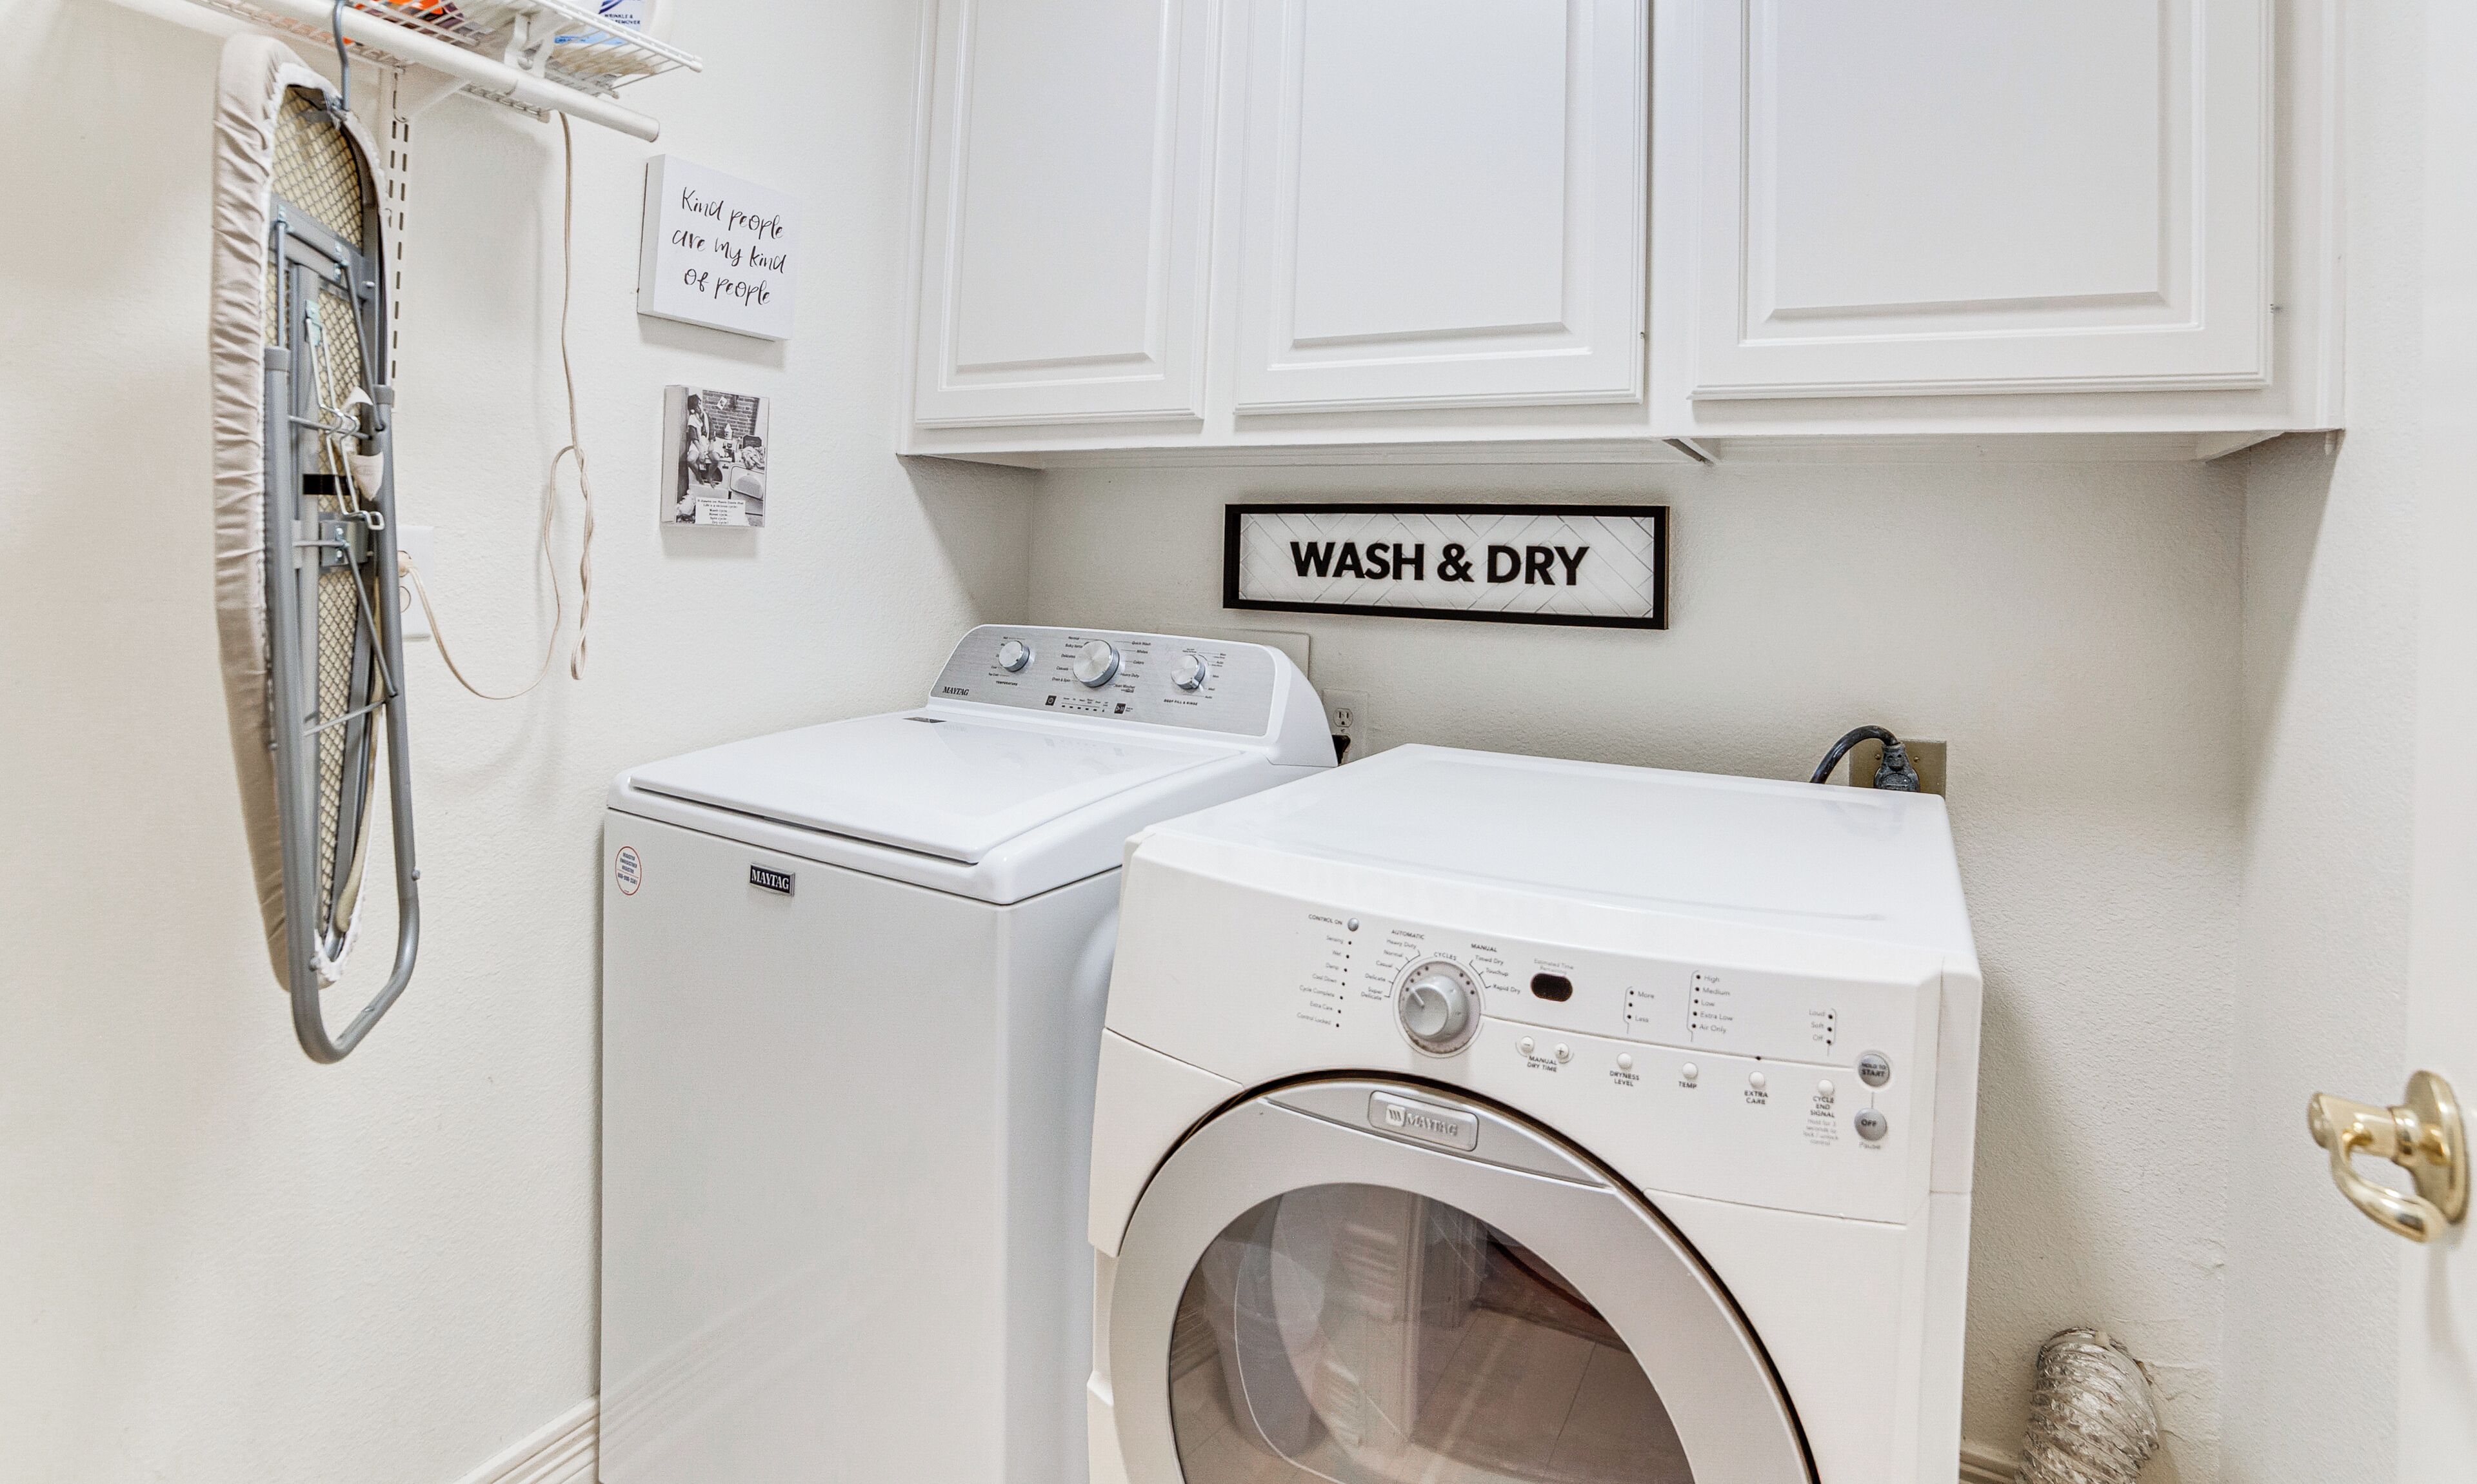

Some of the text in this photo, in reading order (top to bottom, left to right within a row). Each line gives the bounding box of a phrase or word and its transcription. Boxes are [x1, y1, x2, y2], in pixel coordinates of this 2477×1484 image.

[682, 187, 783, 240] Kind people
[672, 230, 786, 273] are my kind
[715, 277, 770, 306] people
[1290, 541, 1589, 586] WASH & DRY
[942, 686, 969, 696] MAYTAG
[751, 869, 789, 889] MAYTAG
[1308, 914, 1333, 924] CONTROL
[1391, 929, 1425, 940] AUTOMATIC
[1471, 944, 1497, 953] MANUAL
[1433, 952, 1457, 961] CYCLES
[1475, 955, 1492, 963] Timed
[1534, 958, 1560, 967] Estimated
[1365, 973, 1386, 982] Delicate
[1704, 975, 1720, 984] High
[1493, 984, 1520, 994] Rapid Dry
[1702, 987, 1731, 996] Medium
[1361, 991, 1382, 1000] Delicate
[1711, 1025, 1726, 1034] Only
[1529, 1055, 1557, 1065] MANUAL
[1542, 1064, 1557, 1073] TIME
[1862, 1069, 1885, 1077] START
[1609, 1070, 1640, 1081] DRYNESS
[1678, 1081, 1698, 1089] TEMP
[1810, 1109, 1835, 1118] SIGNAL
[1406, 1113, 1458, 1137] MAYTAG
[1859, 1142, 1881, 1150] Pause
